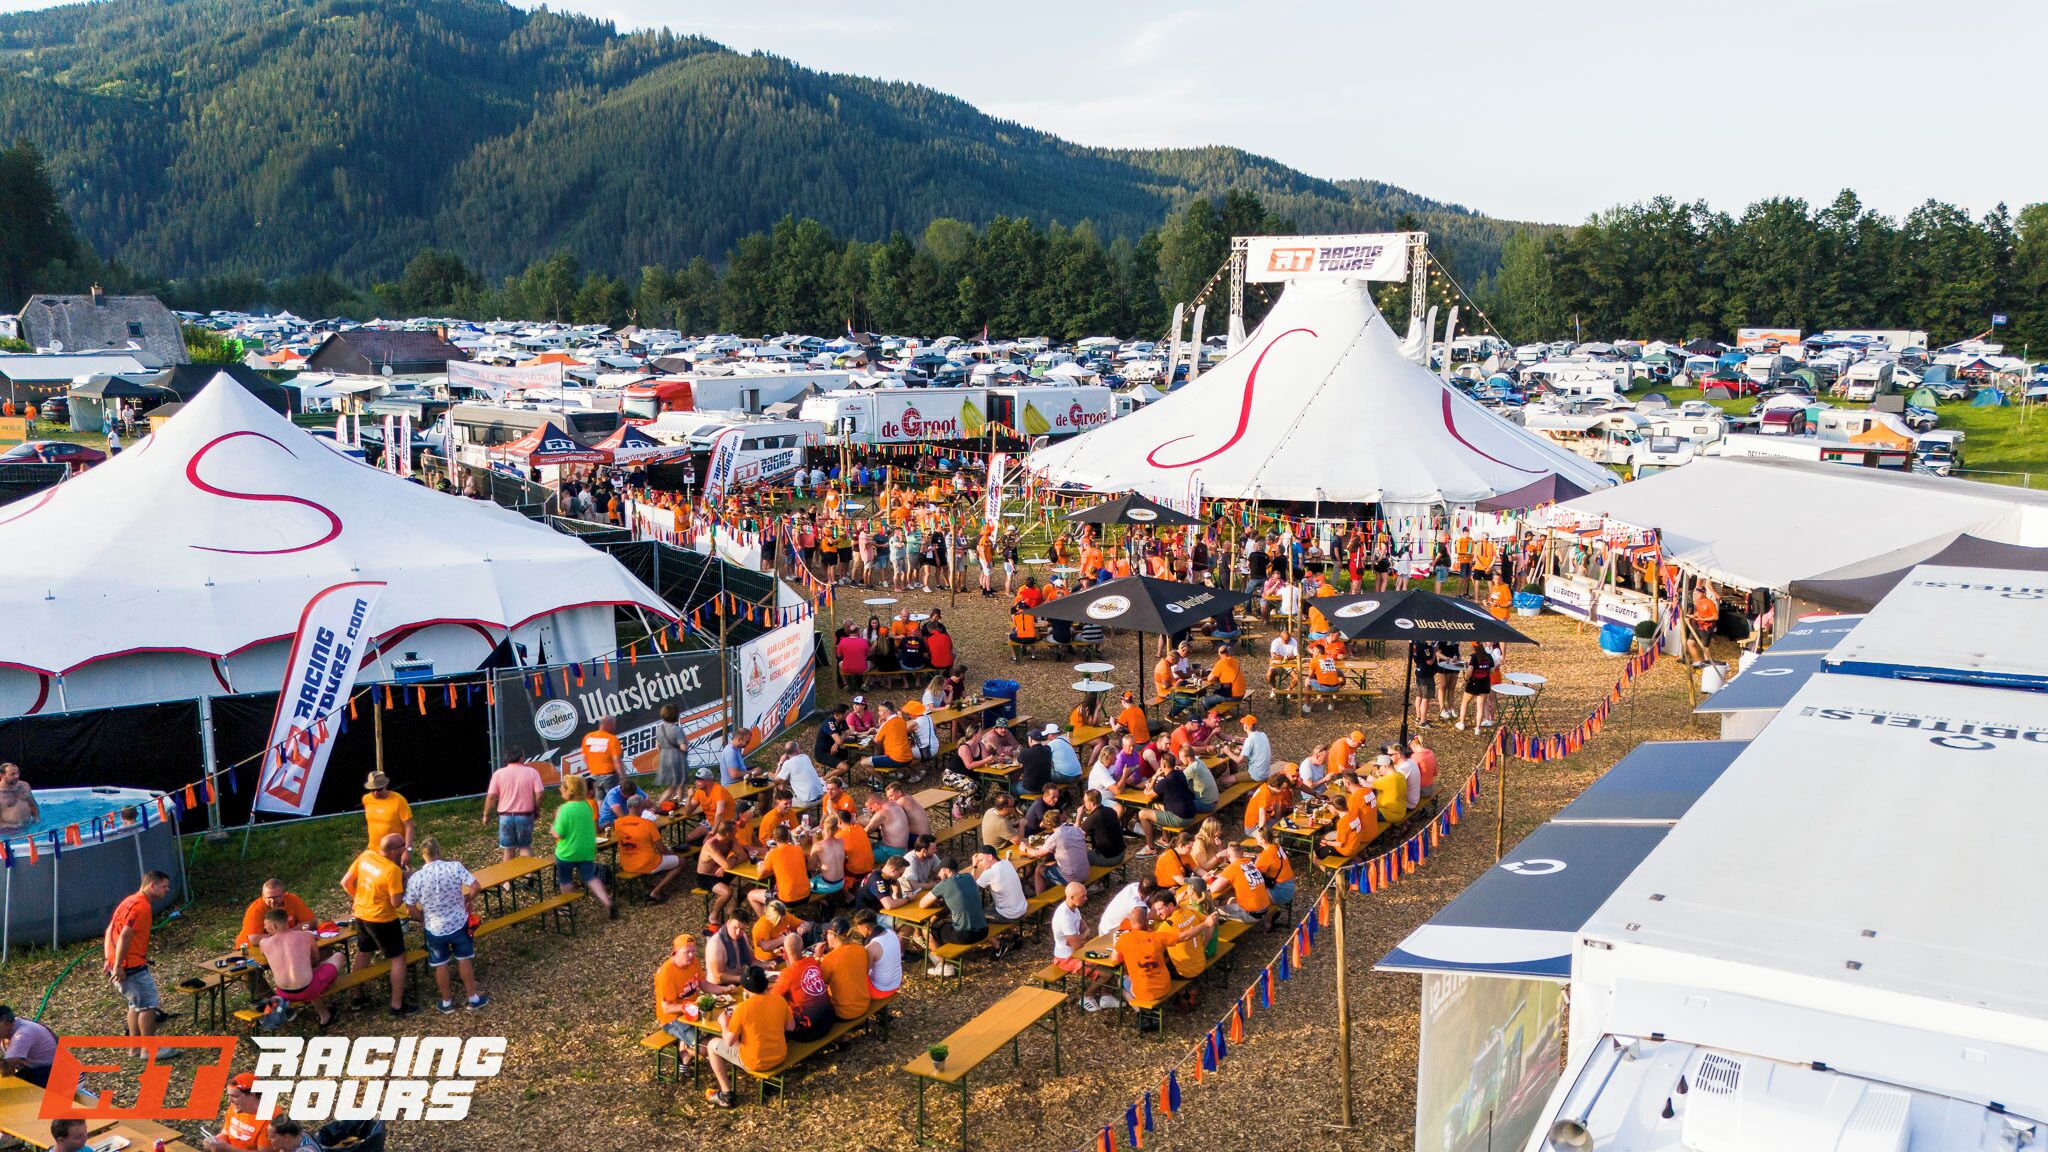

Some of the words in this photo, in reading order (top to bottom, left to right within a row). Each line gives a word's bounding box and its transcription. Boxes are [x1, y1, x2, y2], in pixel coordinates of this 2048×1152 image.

[1320, 246, 1383, 258] RACING
[1319, 259, 1375, 271] TOURS
[882, 421, 899, 437] de
[901, 408, 957, 437] Groot
[1056, 415, 1068, 426] de
[545, 439, 577, 450] RT
[616, 450, 660, 463] MUNTVERKOOP
[760, 450, 794, 465] RACING
[761, 459, 791, 474] TOURS
[1553, 513, 1576, 527] FOOD
[1561, 587, 1580, 600] EVENTS
[1615, 605, 1638, 619] EVENTS
[1414, 618, 1476, 631] Warsteiner
[313, 598, 368, 722] TOURS.com
[294, 626, 335, 720] RACING
[579, 665, 702, 724] Warsteiner
[539, 712, 574, 729] Warsteiner
[1924, 713, 1952, 722] ON
[1962, 718, 2021, 730] HOTEL
